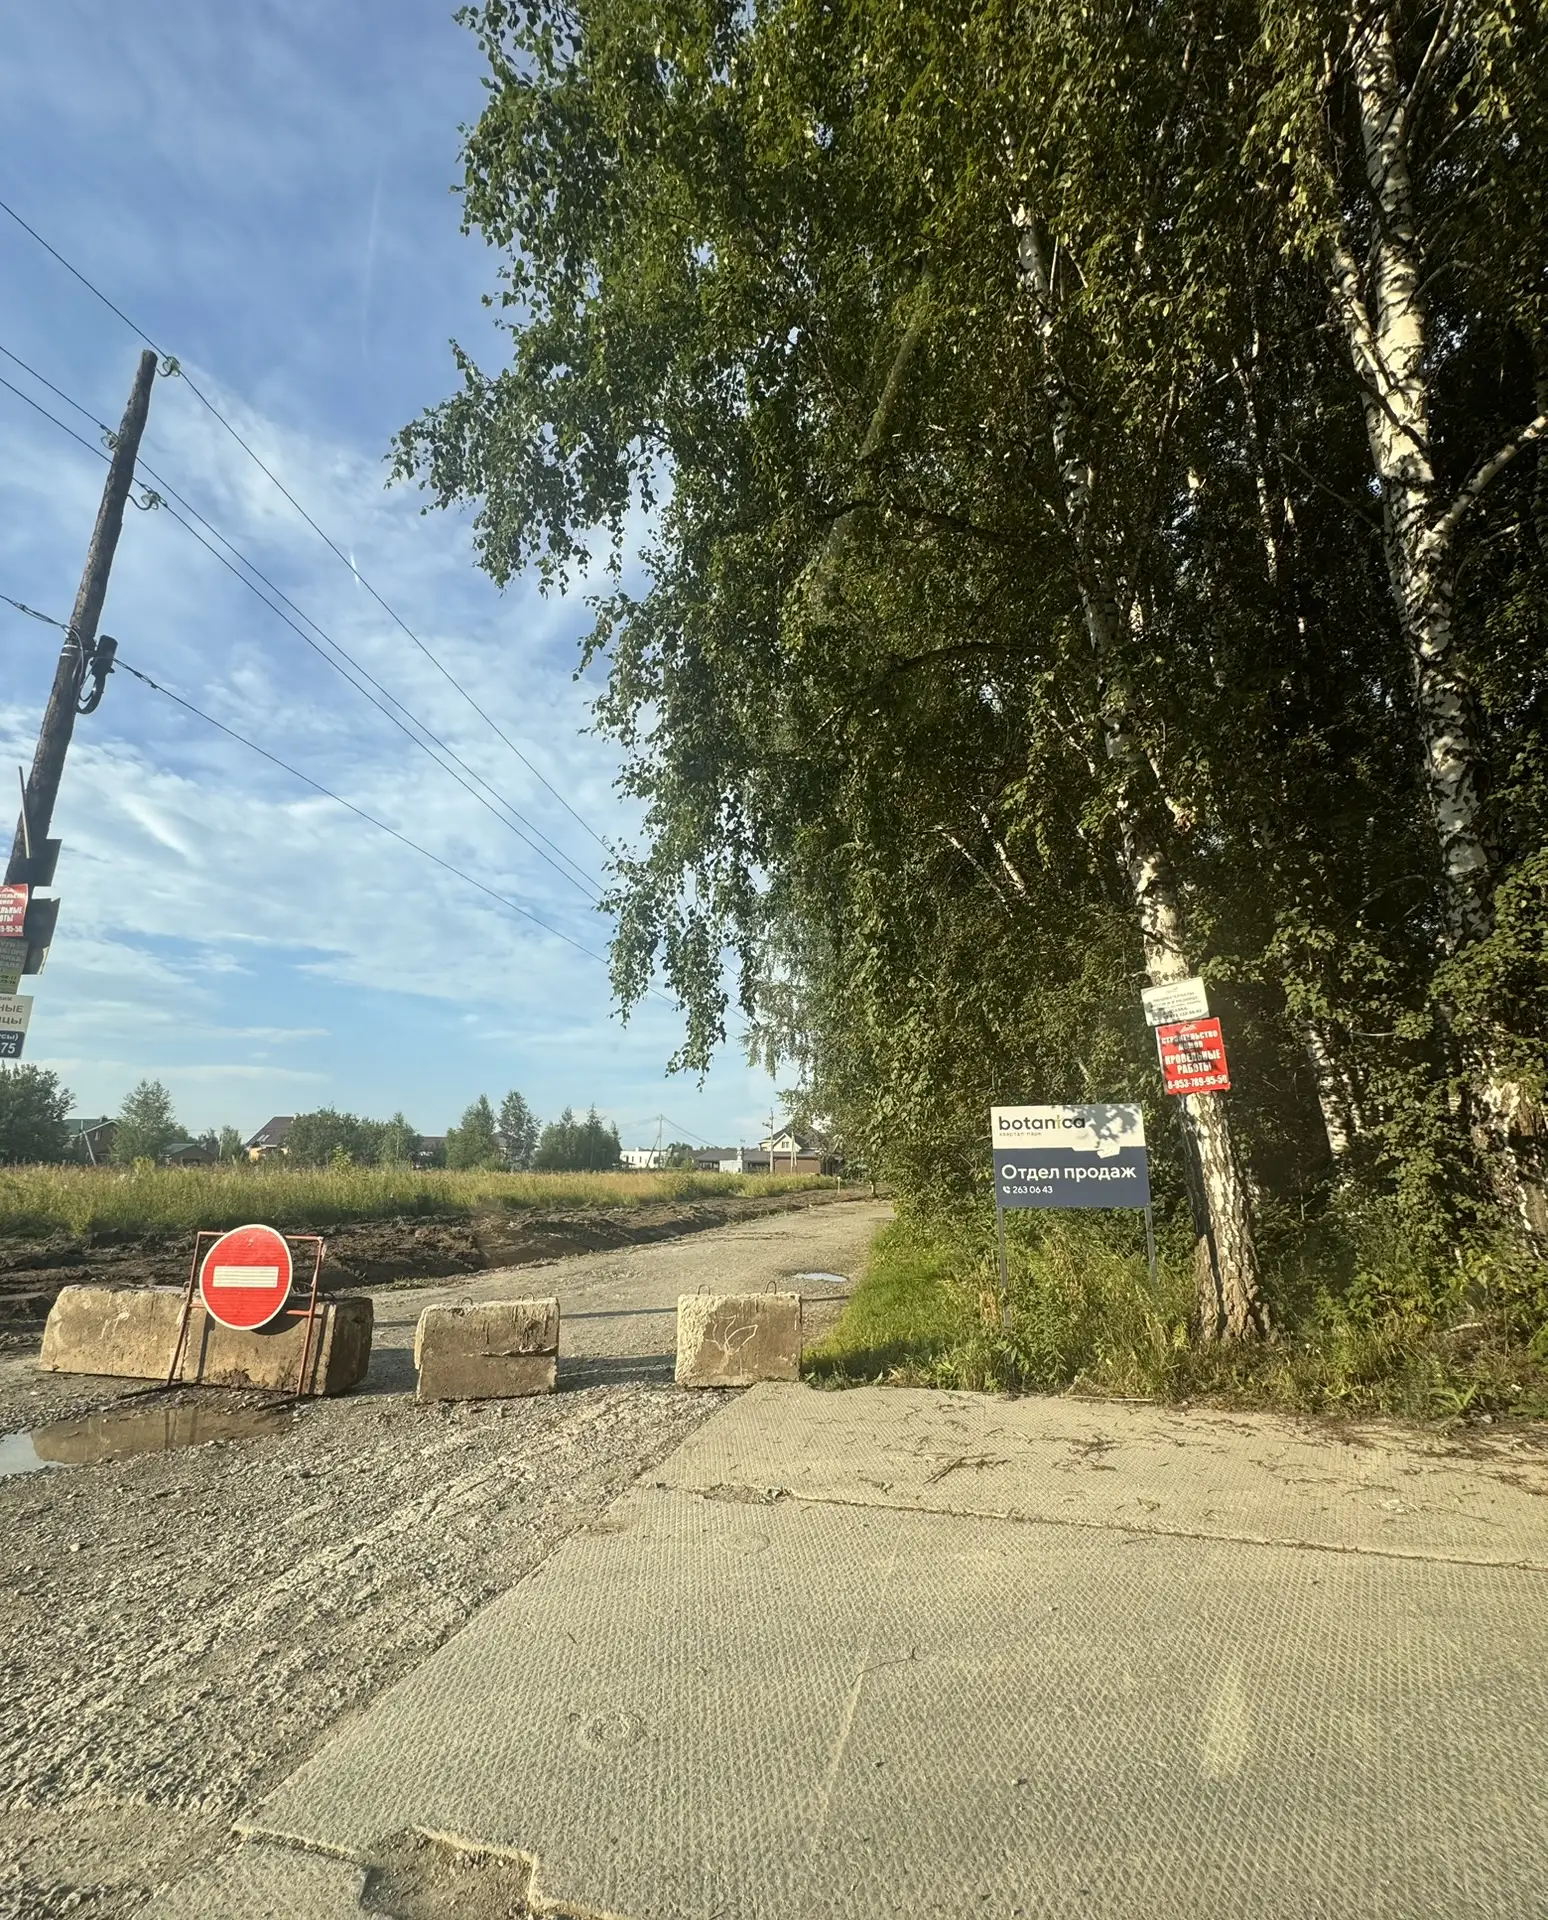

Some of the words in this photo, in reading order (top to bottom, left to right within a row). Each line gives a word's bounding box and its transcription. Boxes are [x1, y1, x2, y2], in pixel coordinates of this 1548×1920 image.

[1161, 1030, 1218, 1044] СТРОИТЕЛЬСТВО
[1178, 1041, 1203, 1051] ДОМОВ
[1164, 1049, 1221, 1065] КРОВЕЛЬНЫЕ
[1176, 1062, 1212, 1075] РАБОТЫ
[998, 1114, 1086, 1131] botanica
[1001, 1164, 1060, 1182] Отдел
[1064, 1166, 1137, 1183] продаж
[1012, 1185, 1028, 1194] 263
[1029, 1185, 1041, 1194] 06
[1041, 1185, 1053, 1194] 43
